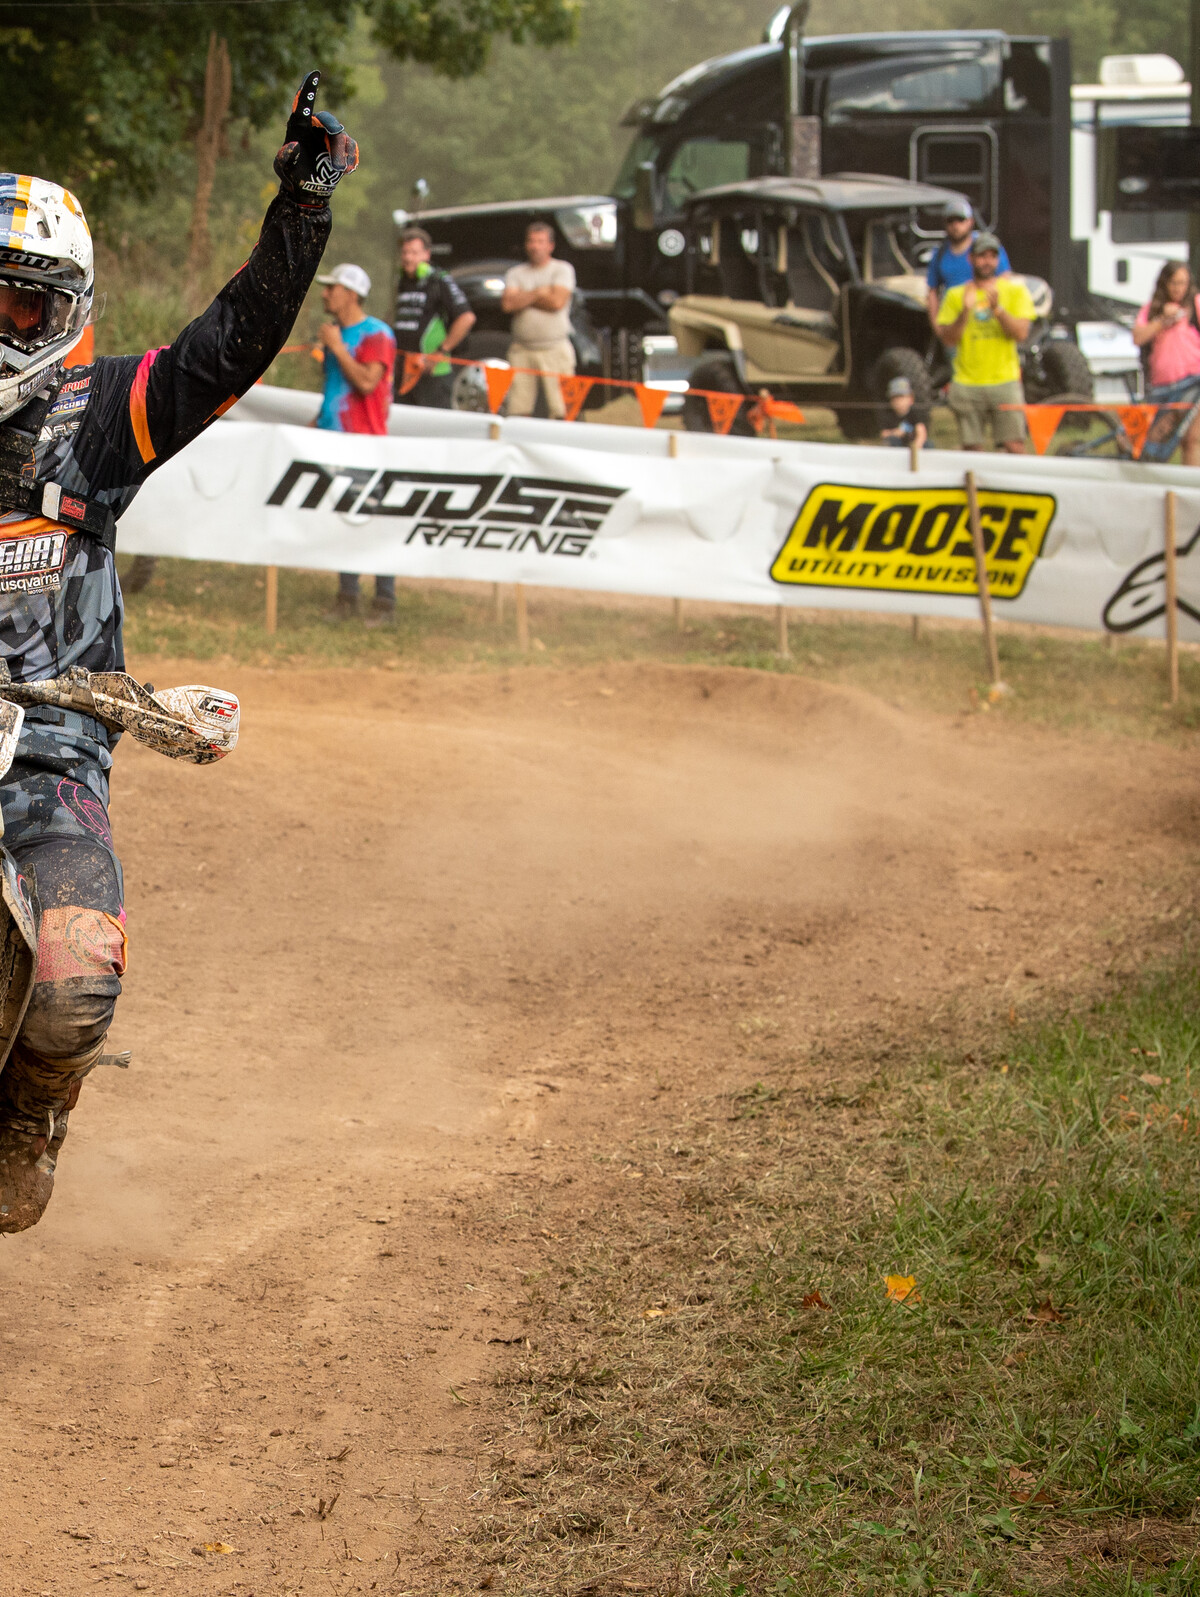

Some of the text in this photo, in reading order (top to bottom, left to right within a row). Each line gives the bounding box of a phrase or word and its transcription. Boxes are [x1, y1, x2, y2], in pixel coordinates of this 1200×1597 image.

[266, 459, 632, 531] MOOSE
[403, 522, 599, 556] RACING
[802, 498, 1038, 561] MOOSE
[787, 558, 889, 579] UTILITY
[198, 696, 238, 713] G2
